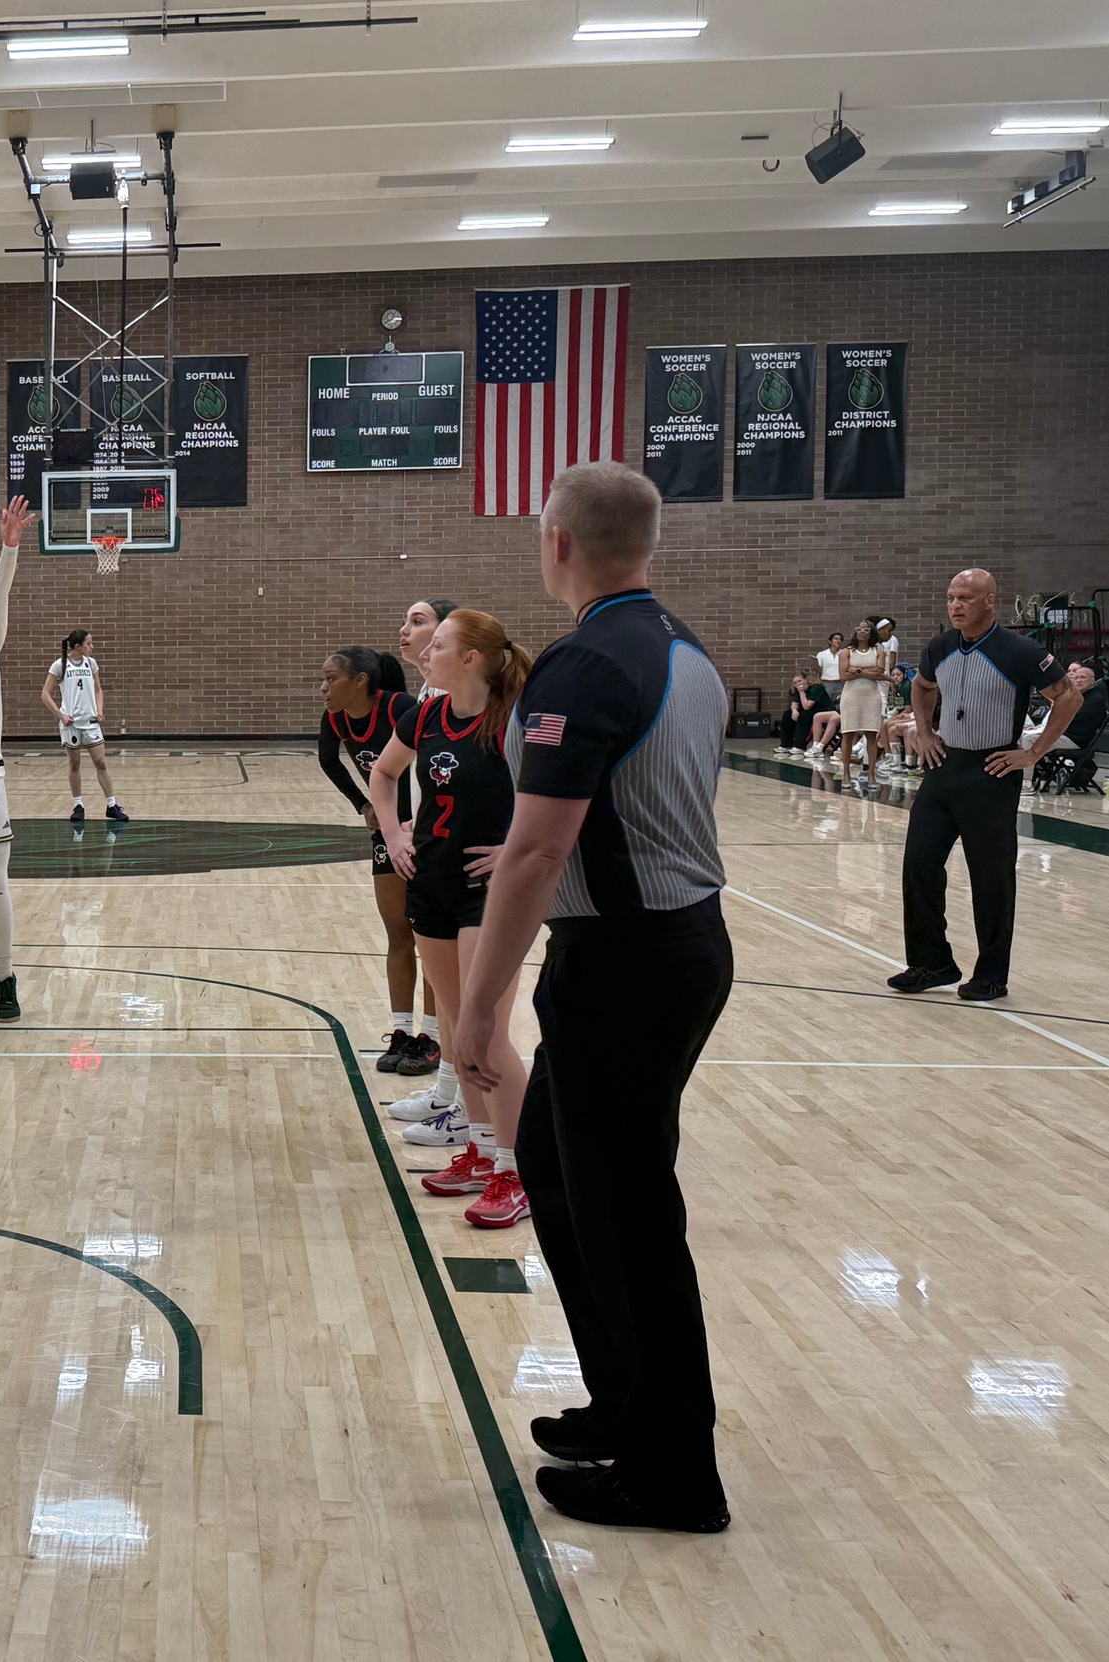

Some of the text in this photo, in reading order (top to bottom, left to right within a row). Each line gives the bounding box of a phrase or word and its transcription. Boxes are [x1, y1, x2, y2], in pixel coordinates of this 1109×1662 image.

[751, 352, 801, 360] WOMEN'S
[842, 350, 892, 358] WOMEN'S
[661, 355, 711, 363] WOMEN'S
[846, 359, 887, 367] SOCCER
[665, 364, 706, 372] SOCCER
[319, 385, 454, 399] HOME GUEST
[842, 411, 889, 419] DISTRICT
[650, 424, 719, 432] CONFERENCE
[748, 422, 801, 430] REGIONAL
[835, 420, 896, 428] CHAMPIONS
[312, 428, 336, 437] FOULS
[744, 431, 805, 440] CHAMPIONS
[181, 440, 239, 448] CHAMPIONS
[433, 457, 457, 465] SCORE
[77, 678, 84, 690] 4
[433, 795, 454, 838] 2
